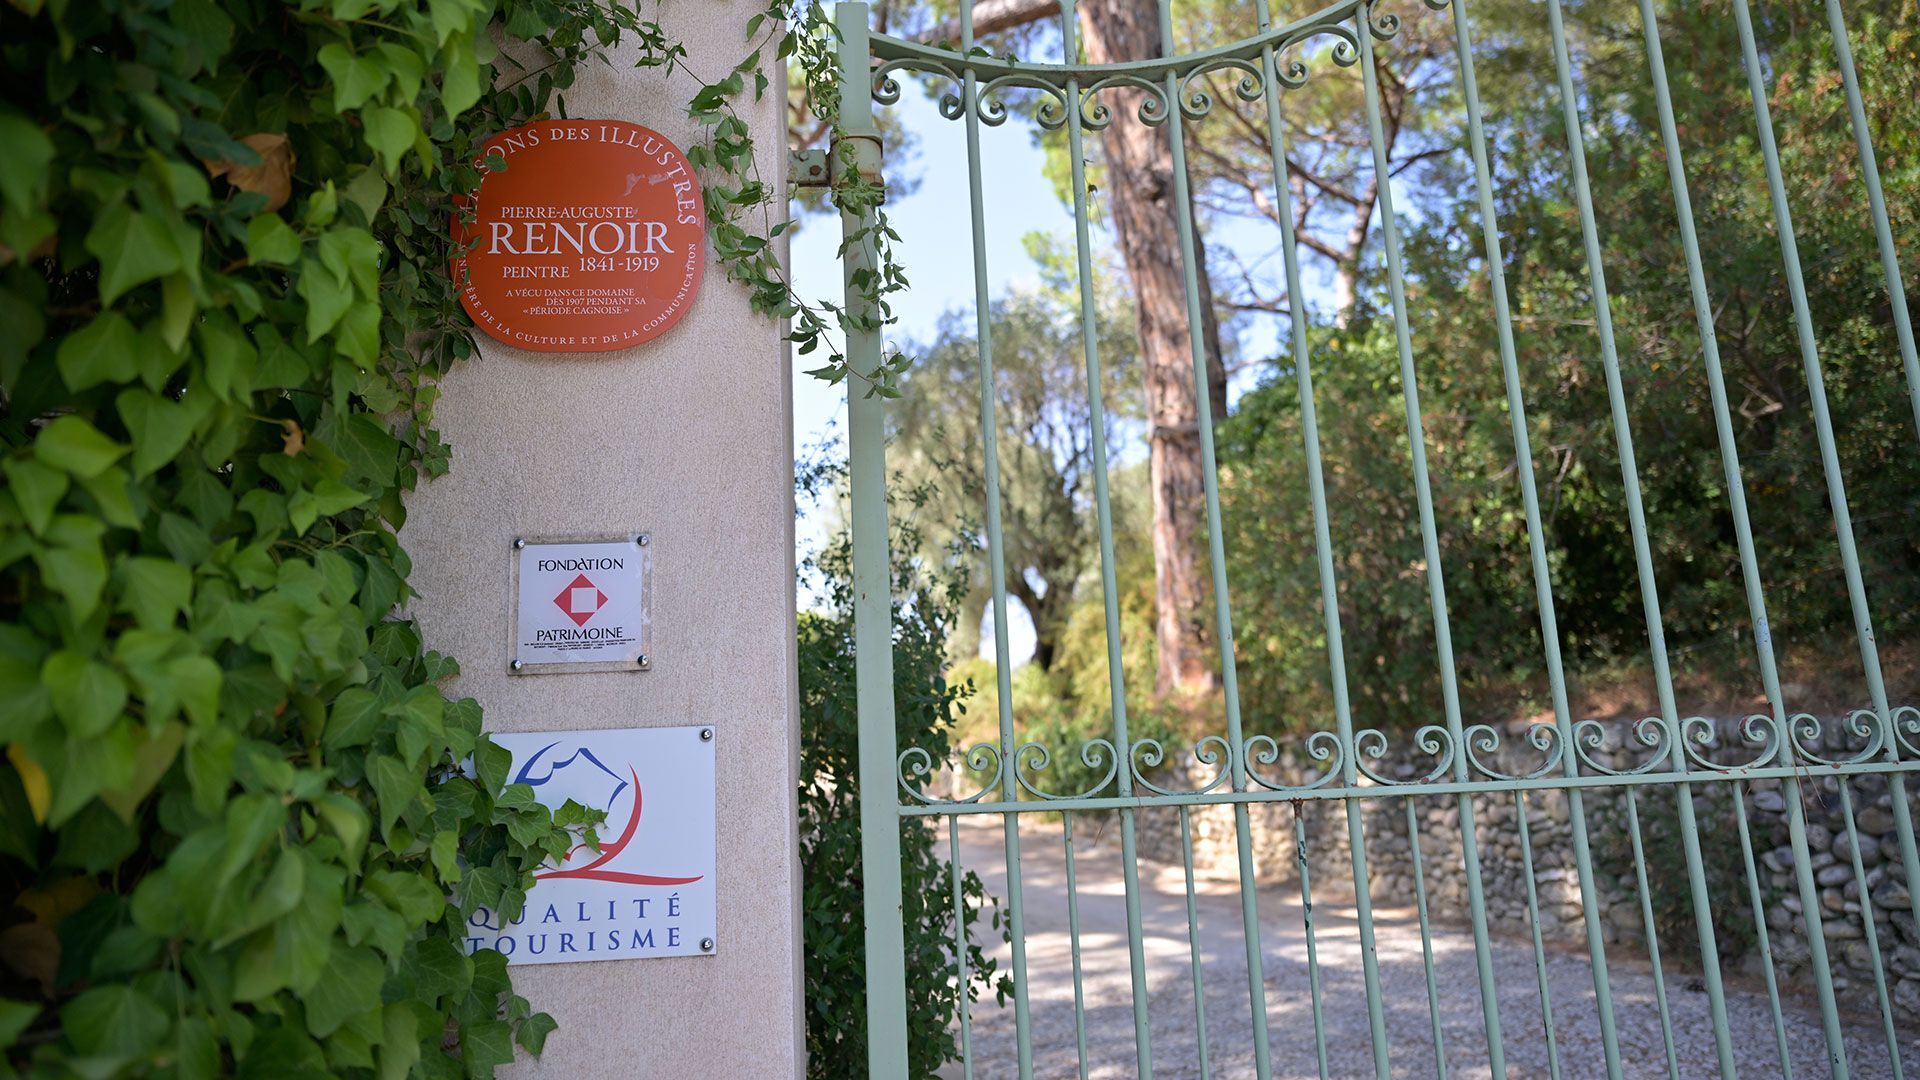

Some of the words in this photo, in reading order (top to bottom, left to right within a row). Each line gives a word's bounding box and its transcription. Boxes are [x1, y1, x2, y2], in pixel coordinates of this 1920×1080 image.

[551, 128, 589, 140] DES
[599, 126, 696, 225] ILLUSTRES
[502, 207, 634, 218] PIERRE-AUGUSTE
[488, 222, 675, 254] RENOIR
[504, 266, 570, 278] PEINTRE
[481, 310, 494, 324] DE
[497, 322, 511, 336] LA
[516, 332, 575, 344] CULTURE
[603, 335, 618, 343] DE
[624, 330, 639, 339] LA
[643, 244, 696, 331] COMMUNICATION
[506, 289, 514, 297] A
[515, 288, 542, 297] VÉCU
[544, 289, 570, 297] DANS
[572, 289, 586, 297] CE
[587, 288, 635, 297] DOMAINE
[546, 296, 565, 305] DÈS
[567, 297, 584, 305] 1907
[587, 297, 634, 305] PENDANT
[635, 297, 647, 305] SA
[538, 558, 623, 571] FONDATION
[536, 627, 623, 641] PATRIMOINE
[468, 892, 681, 930] QUALITÉ
[467, 927, 681, 956] TOURISME
